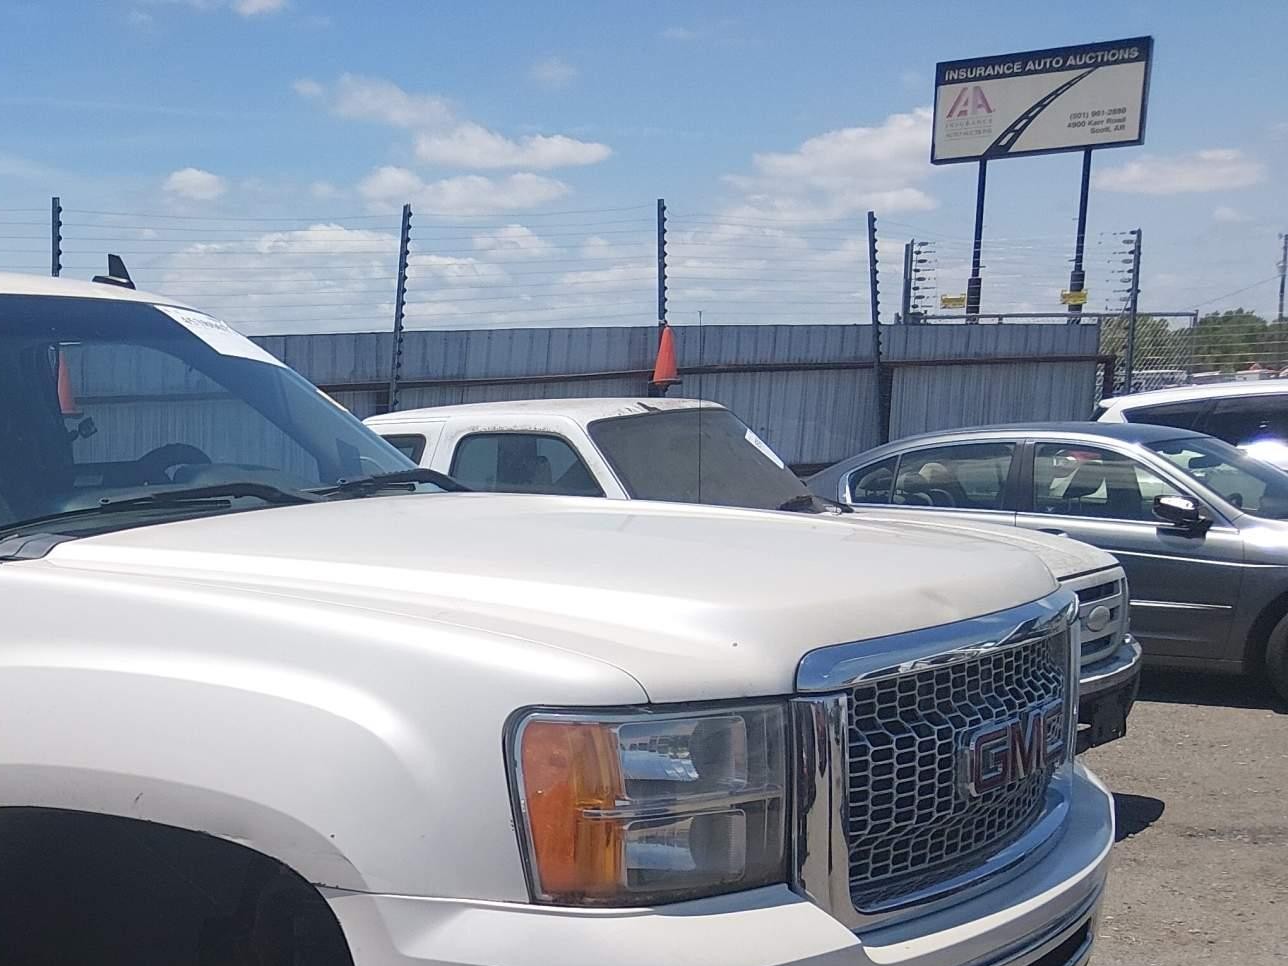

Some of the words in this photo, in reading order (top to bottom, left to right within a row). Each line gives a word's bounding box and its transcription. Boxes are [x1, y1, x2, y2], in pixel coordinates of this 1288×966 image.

[945, 61, 1022, 81] INSURANCE
[1024, 56, 1063, 72] AUTO
[1065, 47, 1140, 66] AUCTIONS
[969, 698, 1063, 798] GMC
